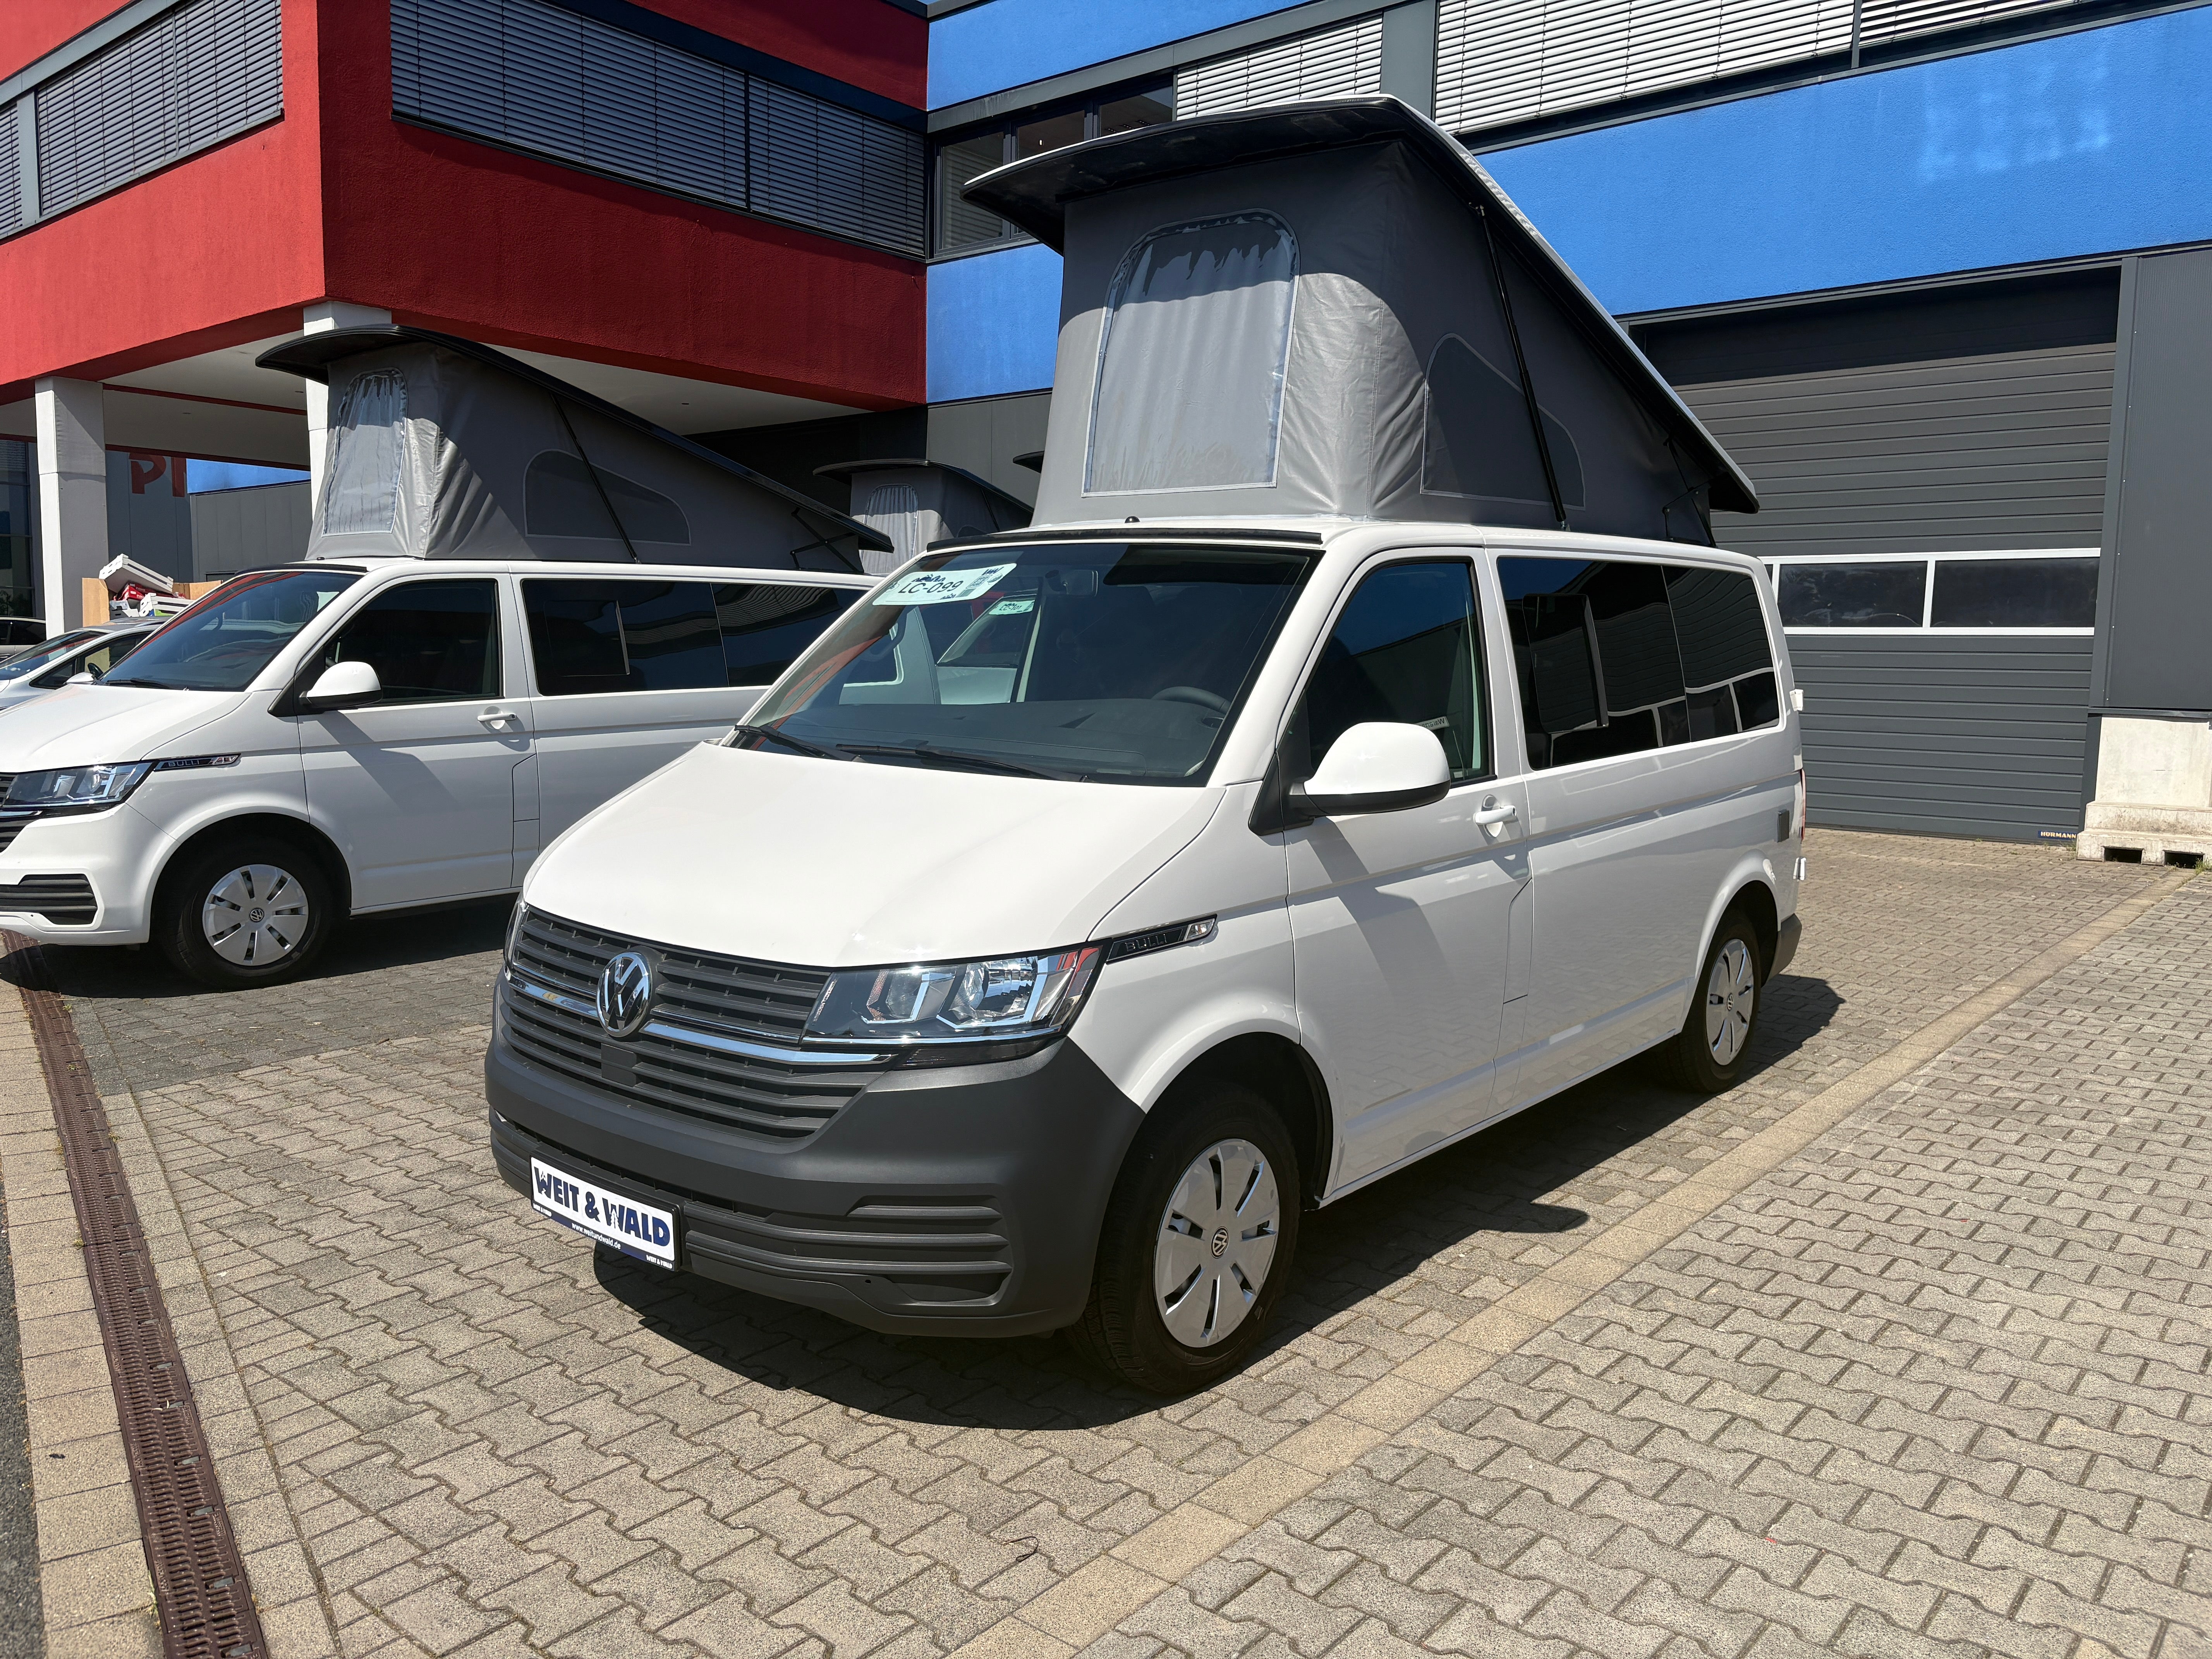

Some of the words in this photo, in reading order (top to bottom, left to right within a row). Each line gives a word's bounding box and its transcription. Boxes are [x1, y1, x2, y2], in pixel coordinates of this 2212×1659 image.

[898, 580, 963, 594] LC-099
[1125, 934, 1167, 951] BULLI
[534, 1166, 579, 1212] WEIT
[585, 1191, 601, 1223] &
[602, 1197, 670, 1247] WALD
[572, 1222, 621, 1250] www.weitundwald.de
